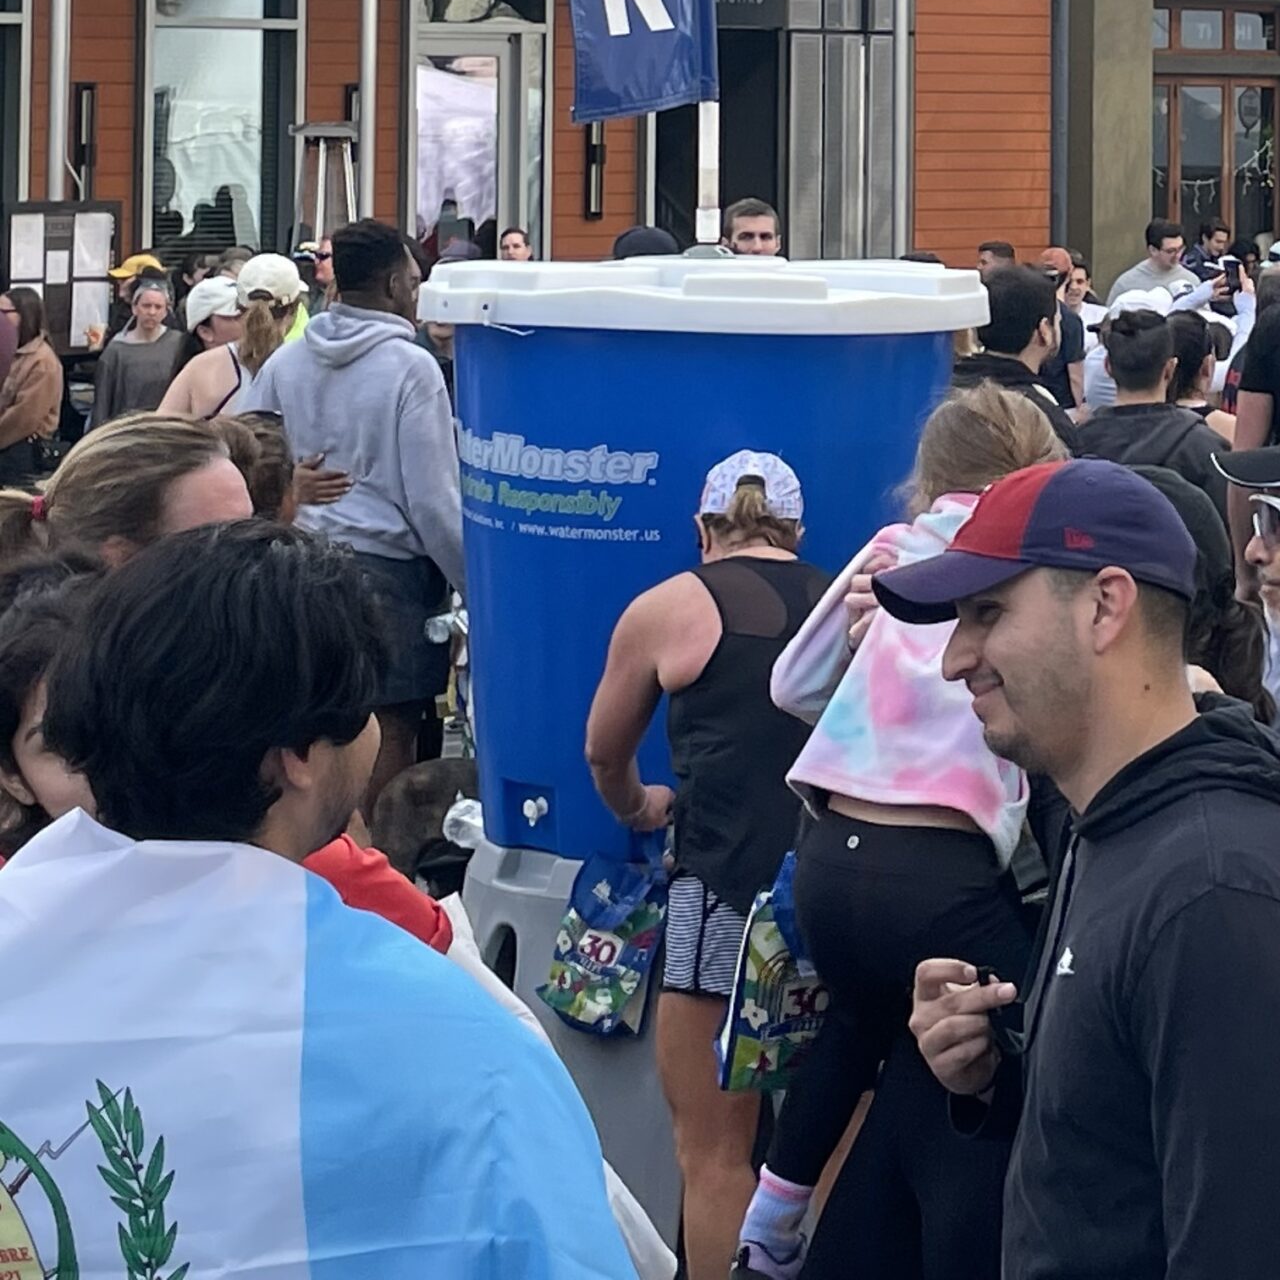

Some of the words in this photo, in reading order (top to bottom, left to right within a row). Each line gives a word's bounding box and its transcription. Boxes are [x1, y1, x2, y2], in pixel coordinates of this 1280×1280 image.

[498, 480, 622, 521] Responsibly
[518, 521, 661, 542] www.watermonster.us
[579, 933, 617, 966] 30
